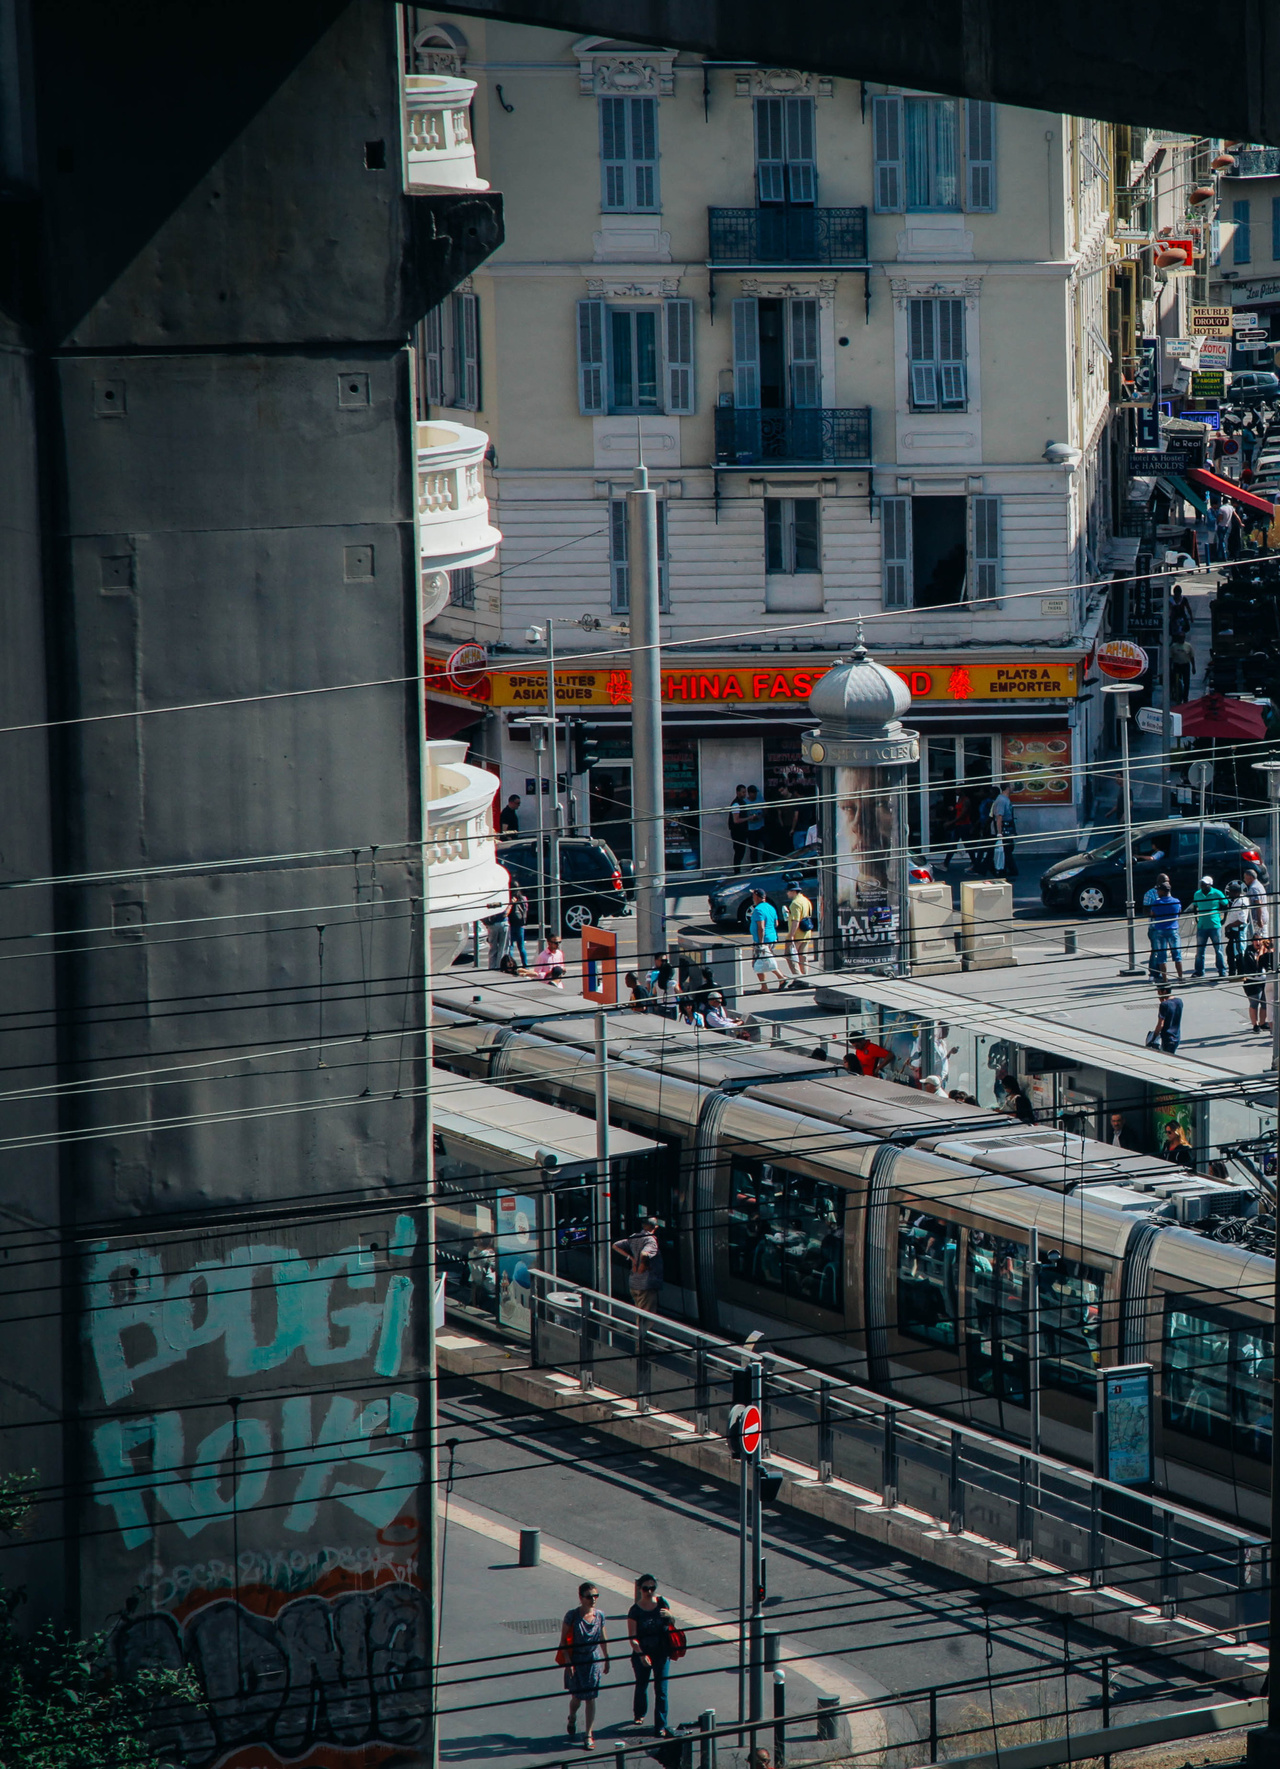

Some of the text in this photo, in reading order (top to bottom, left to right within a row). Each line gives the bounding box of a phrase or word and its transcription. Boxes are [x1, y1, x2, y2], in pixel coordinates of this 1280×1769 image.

[1193, 308, 1230, 316] MEUBLE
[1194, 317, 1228, 326] DROUOT
[1193, 327, 1223, 335] HOTEL
[996, 669, 1050, 680] PLATS A
[509, 675, 596, 687] SPECLITES
[660, 671, 825, 700] HINA FAS
[990, 681, 1061, 693] EMPORTER
[512, 688, 593, 700] ASIATQUES
[830, 746, 908, 761] SPECTACLES
[842, 926, 897, 942] HAUTE
